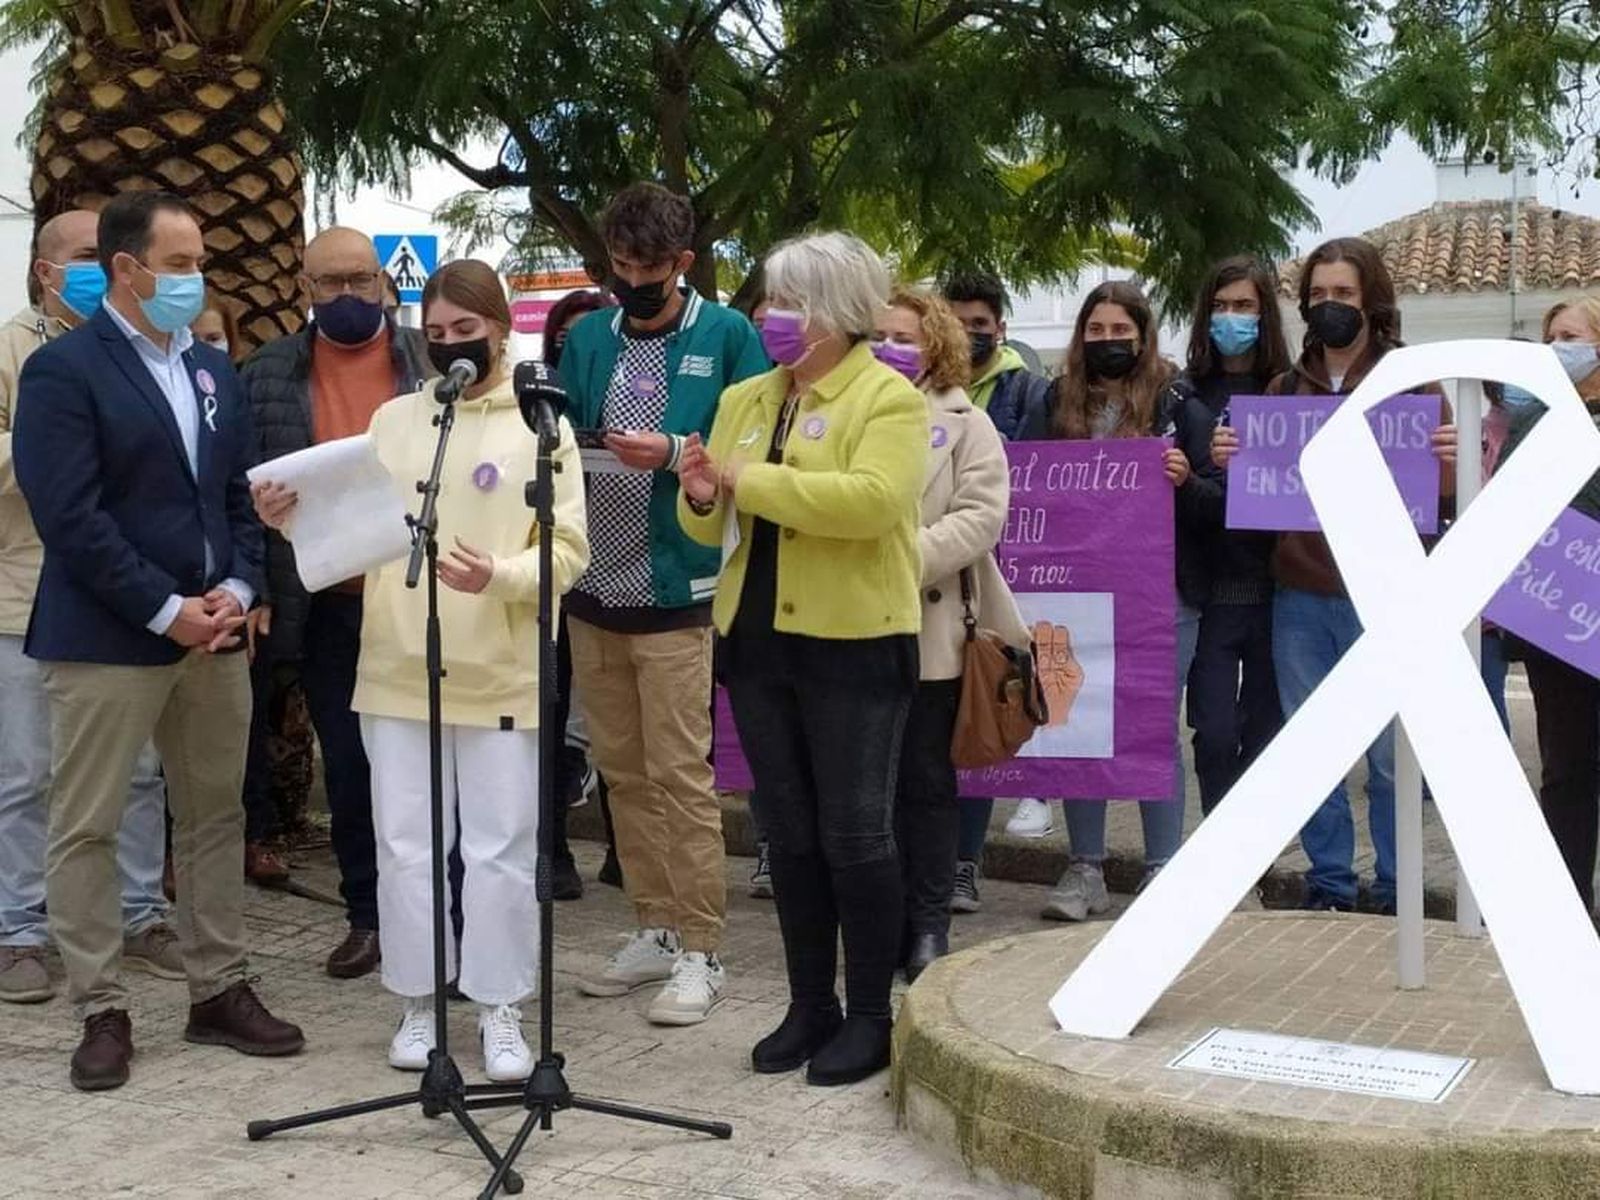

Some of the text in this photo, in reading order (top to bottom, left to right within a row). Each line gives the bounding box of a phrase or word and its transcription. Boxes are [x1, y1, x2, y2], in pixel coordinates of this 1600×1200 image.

[1246, 412, 1288, 449] NO
[1046, 448, 1141, 492] contra
[1246, 466, 1277, 496] EN
